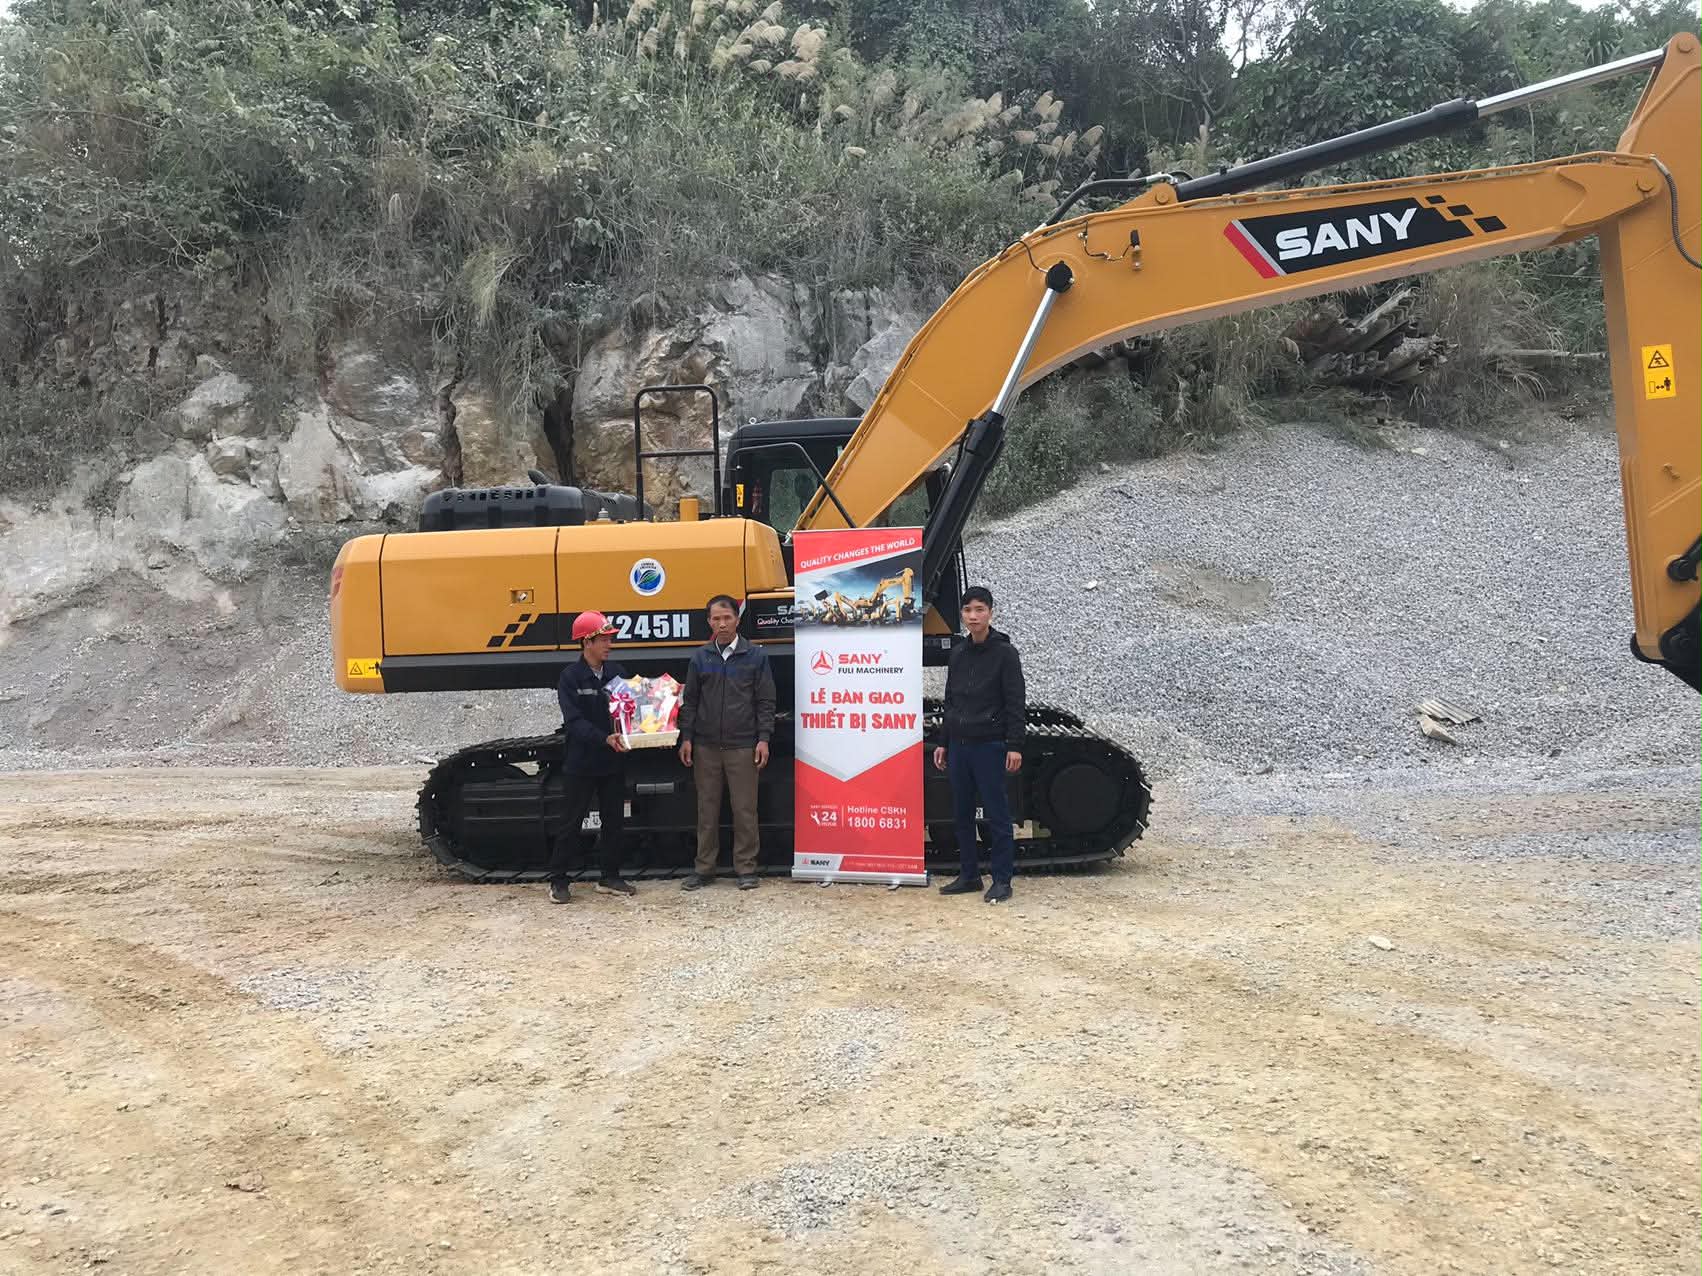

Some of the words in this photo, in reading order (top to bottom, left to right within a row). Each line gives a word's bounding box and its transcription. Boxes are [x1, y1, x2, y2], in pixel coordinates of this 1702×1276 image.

[1275, 207, 1418, 261] SANY
[800, 556, 833, 569] QUALITY
[833, 548, 869, 561] CHANGES
[871, 544, 886, 553] THE
[886, 537, 915, 549] WORLD
[757, 617, 779, 625] Quality
[838, 653, 882, 665] SANY
[838, 666, 854, 674] FULI
[855, 666, 904, 674] MACHINERY
[810, 687, 826, 704] LỄ
[832, 689, 863, 704] BÀN
[868, 691, 905, 705] GIAO
[800, 708, 845, 729] THIẾT
[849, 712, 867, 732] BỊ
[871, 712, 917, 729] SANY
[847, 805, 878, 814] Hotline
[880, 807, 907, 815] CSKH
[821, 811, 837, 822] 24
[847, 817, 875, 828] 1800
[879, 818, 907, 829] 6831
